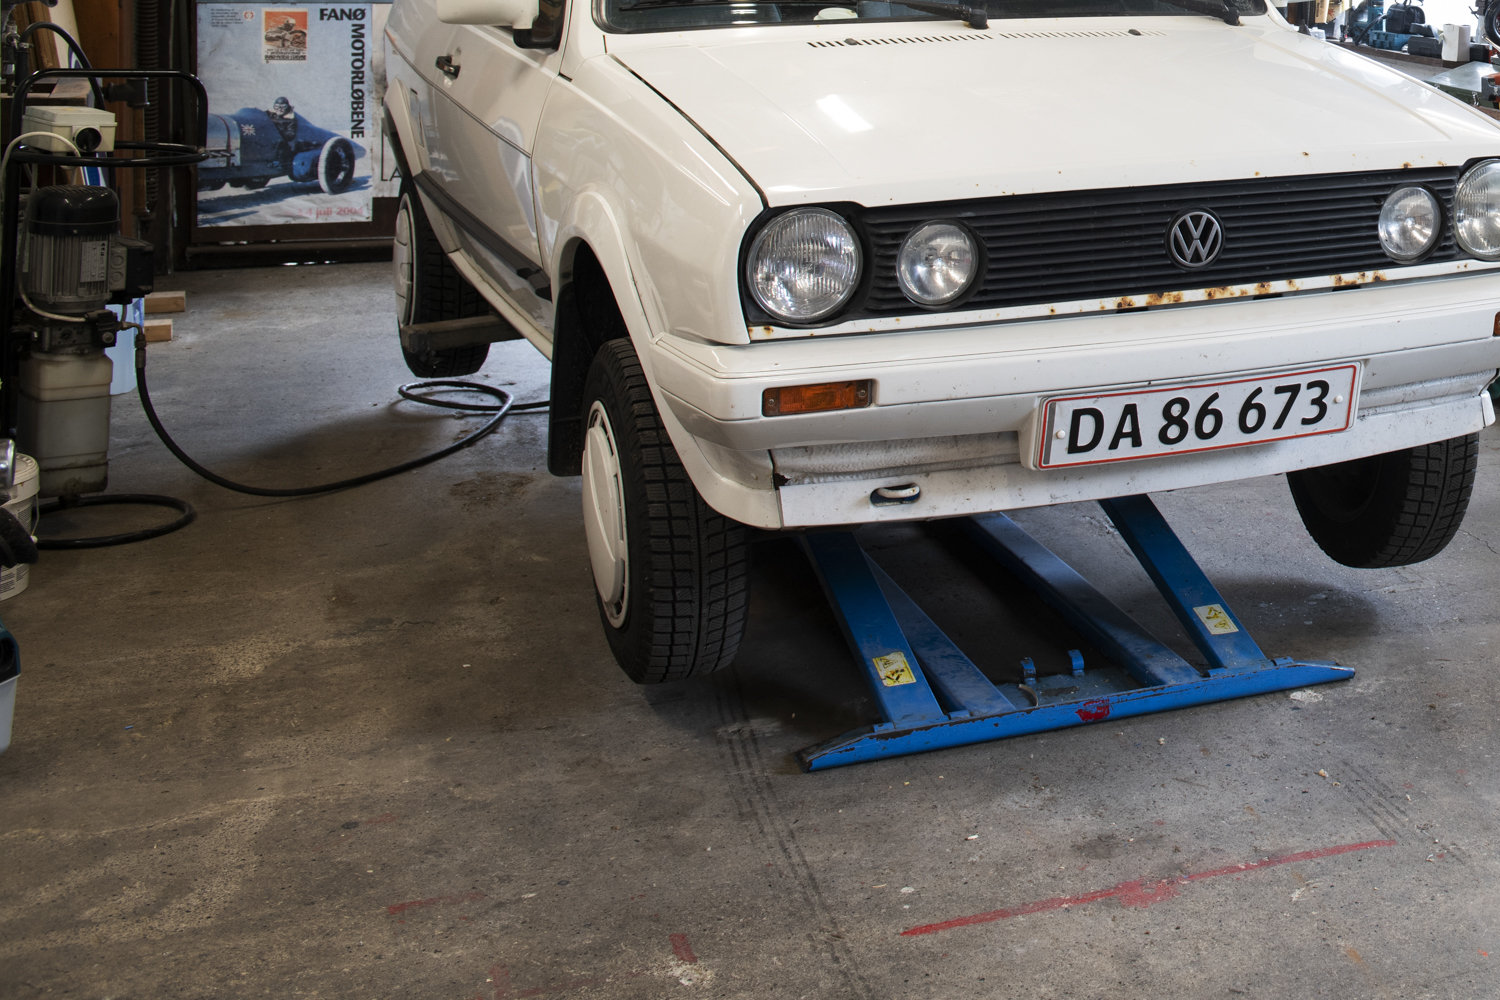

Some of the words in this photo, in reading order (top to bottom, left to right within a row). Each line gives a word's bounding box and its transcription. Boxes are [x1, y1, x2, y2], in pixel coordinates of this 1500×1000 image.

[319, 8, 366, 21] FANØ
[351, 23, 366, 139] MOTORLØBENE
[1067, 402, 1143, 455] DA
[1158, 391, 1224, 446] 86
[1238, 379, 1331, 434] 673
